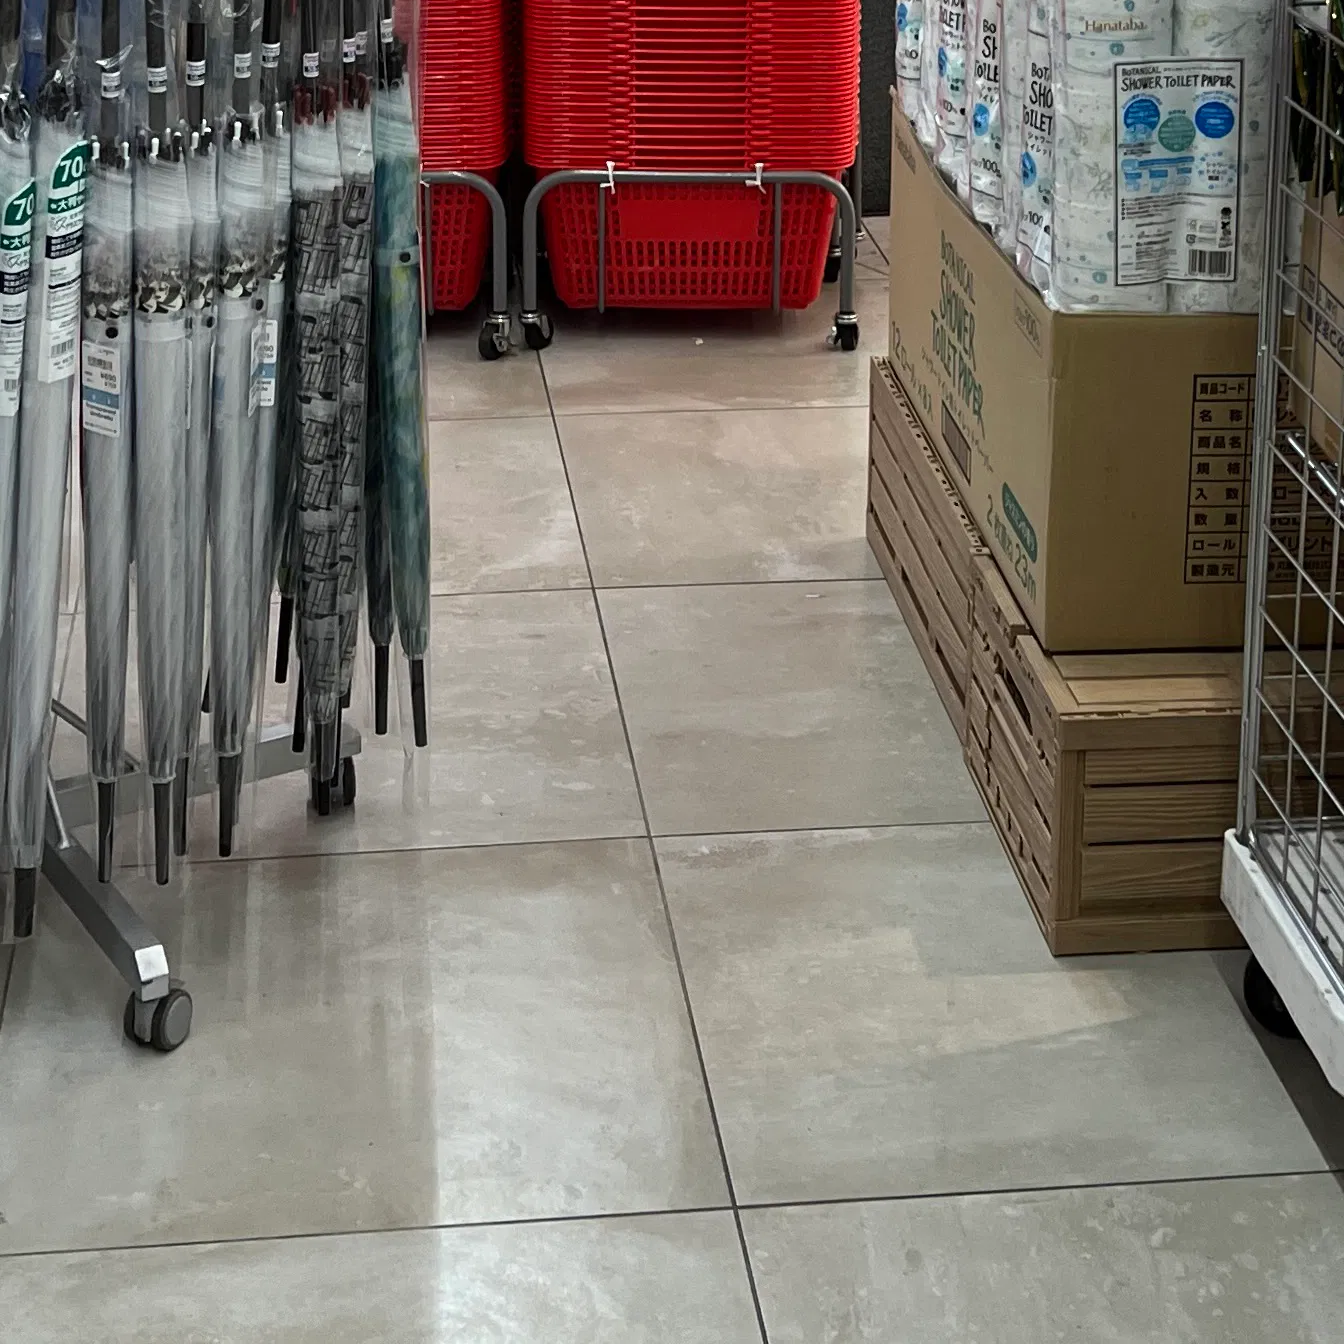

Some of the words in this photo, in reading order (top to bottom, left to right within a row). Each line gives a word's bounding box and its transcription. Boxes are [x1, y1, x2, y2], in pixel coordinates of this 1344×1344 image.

[1084, 17, 1146, 34] Hanataba
[1120, 75, 1163, 93] SHOWER
[1200, 73, 1236, 89] PAPER
[938, 268, 977, 372] SHOWER
[955, 356, 986, 441] PAPER
[1192, 537, 1236, 552] ロール
